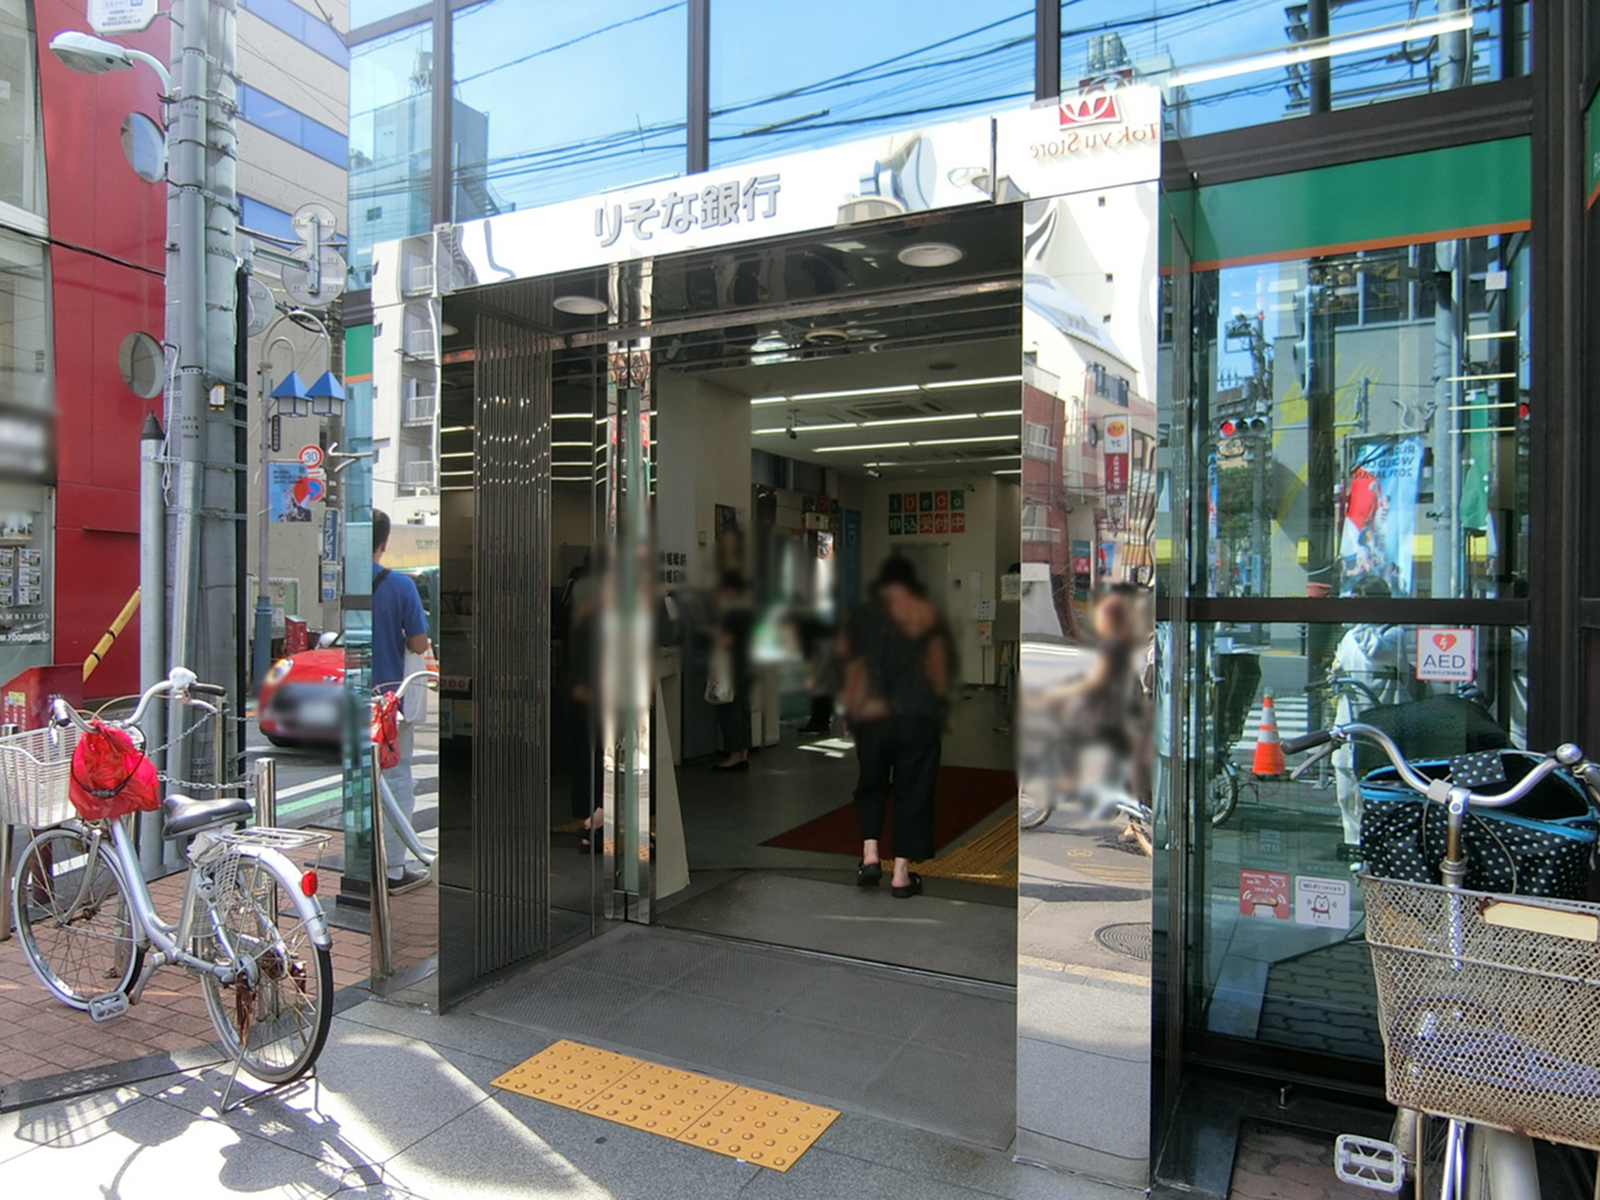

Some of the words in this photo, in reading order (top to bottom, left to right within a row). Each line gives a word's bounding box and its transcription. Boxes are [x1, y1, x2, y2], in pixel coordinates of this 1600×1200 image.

[594, 173, 781, 248] りそな銀行
[304, 451, 319, 463] 30
[891, 493, 963, 511] iDeCo
[889, 516, 963, 533] 申込受付中
[1423, 654, 1466, 669] AED
